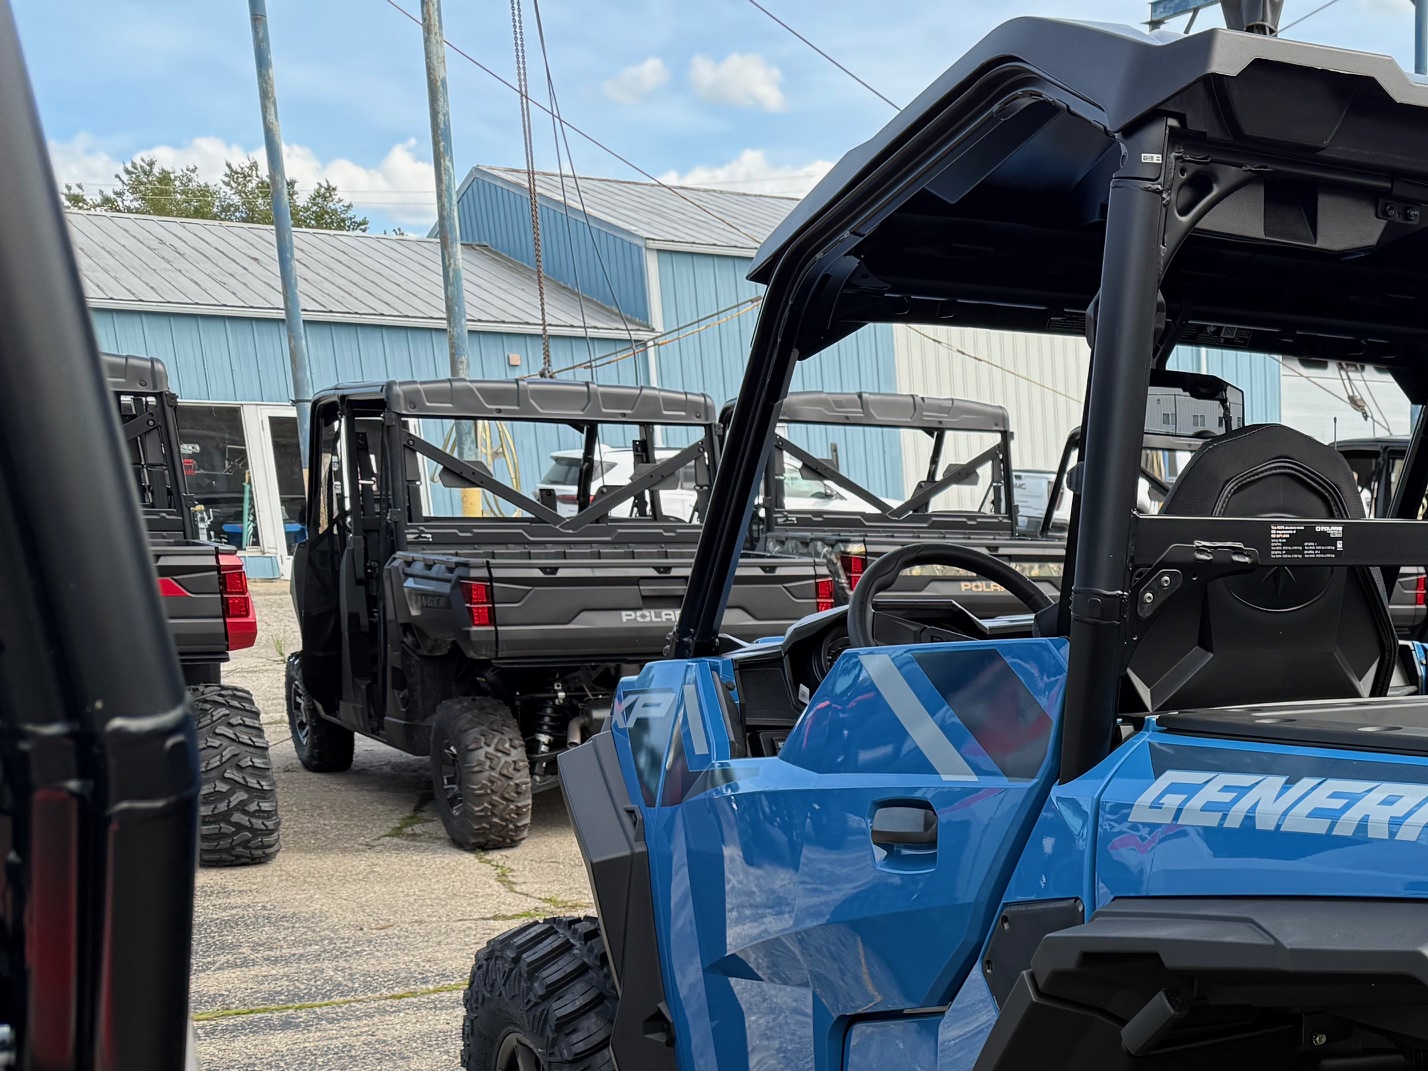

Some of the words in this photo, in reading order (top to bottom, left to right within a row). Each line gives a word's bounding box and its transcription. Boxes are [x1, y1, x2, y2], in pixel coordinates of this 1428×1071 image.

[960, 582, 1005, 592] POLA
[621, 610, 680, 623] POLA
[612, 693, 676, 729] XP
